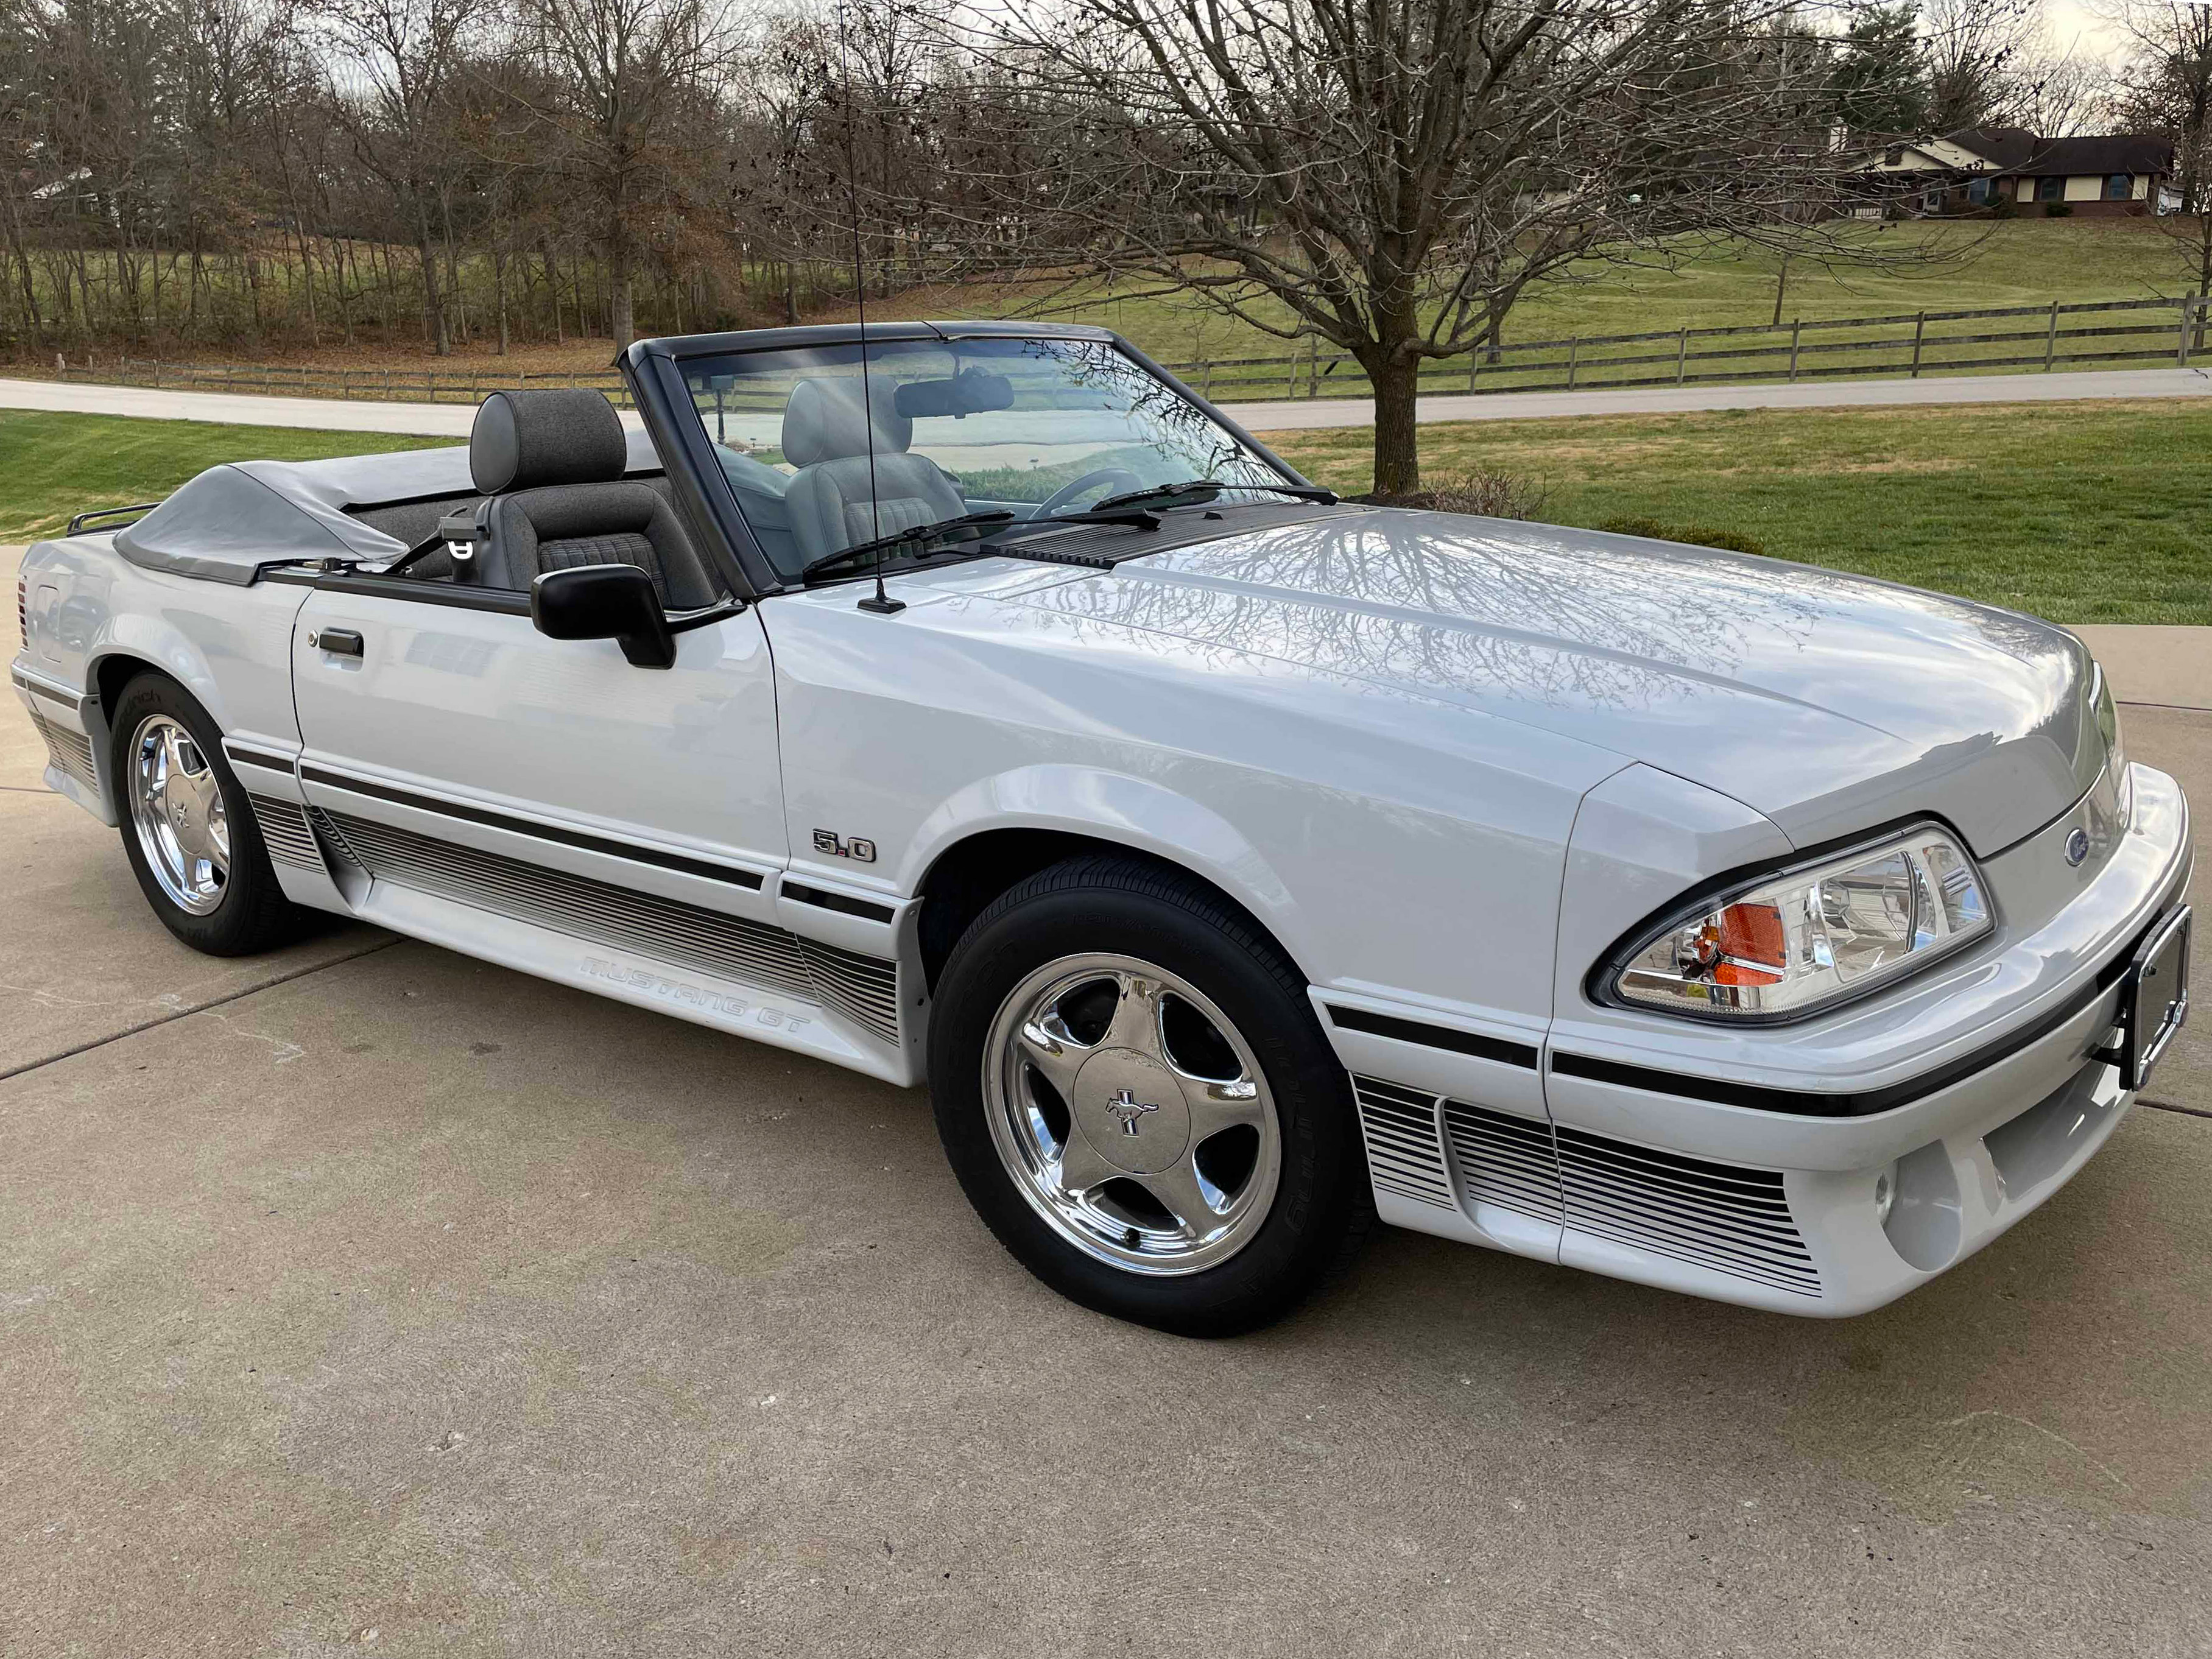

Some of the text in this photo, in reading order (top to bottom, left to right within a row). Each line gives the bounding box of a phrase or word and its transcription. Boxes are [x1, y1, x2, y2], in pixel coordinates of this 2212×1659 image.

[812, 828, 876, 862] 5.0
[579, 956, 811, 1033] MUSTANG GT
